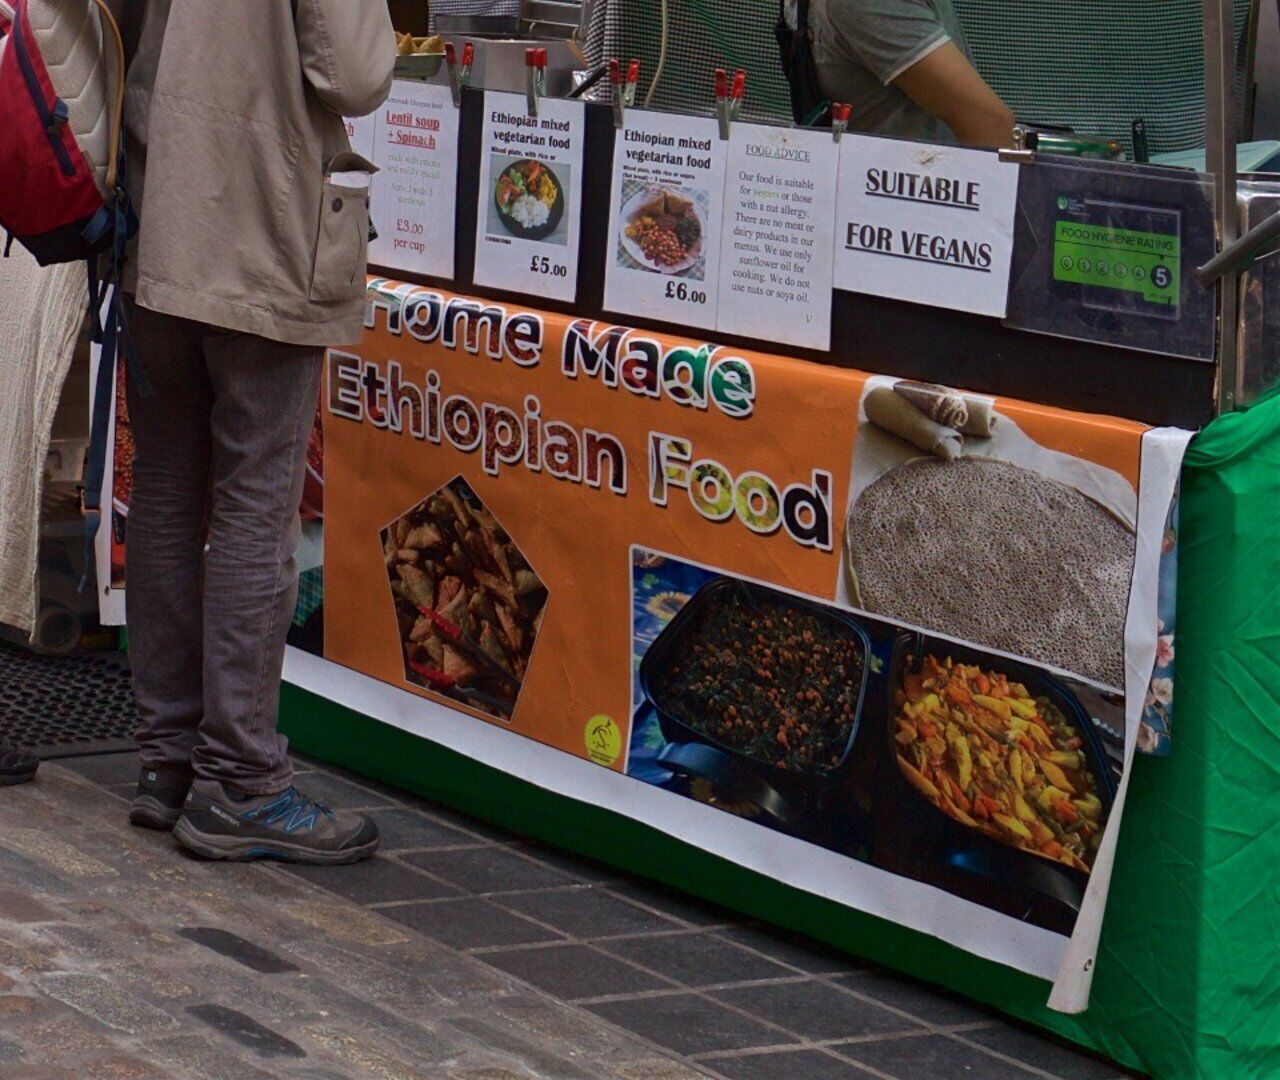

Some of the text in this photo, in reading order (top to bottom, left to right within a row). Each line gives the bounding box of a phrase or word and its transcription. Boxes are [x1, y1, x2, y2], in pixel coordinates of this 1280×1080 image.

[385, 110, 440, 132] Lentil soup
[491, 111, 570, 133] Ethiopian mixed
[395, 129, 437, 150] Spinach
[493, 129, 571, 150] vegetarian food
[623, 128, 712, 152] Ethiopian mixed
[626, 148, 711, 170] vegetarian food
[745, 143, 811, 164] FOOD ADVICE
[739, 171, 815, 191] Our food is suitable
[865, 167, 981, 210] SUITABLE
[739, 183, 752, 196] for
[780, 191, 790, 201] or
[791, 190, 813, 205] those
[740, 198, 759, 211] with
[766, 203, 779, 214] nut
[780, 203, 810, 220] allergy.
[395, 217, 424, 236] £3.00
[735, 211, 815, 232] There are no meat or
[393, 238, 426, 254] per cup
[733, 225, 814, 248] dairy products in our
[846, 221, 993, 270] FOR VEGANS
[1061, 226, 1174, 252] FOOD HYGIENE RATING
[733, 241, 813, 263] menus. We use only
[529, 254, 568, 278] £5.00
[739, 254, 805, 275] sunflower oil for
[732, 269, 811, 290] cooking. We do not
[664, 280, 707, 305] £6.00
[731, 282, 811, 304] use nuts or soya oil.
[364, 279, 756, 417] Home Made
[326, 348, 835, 551] Ethiopian Food
